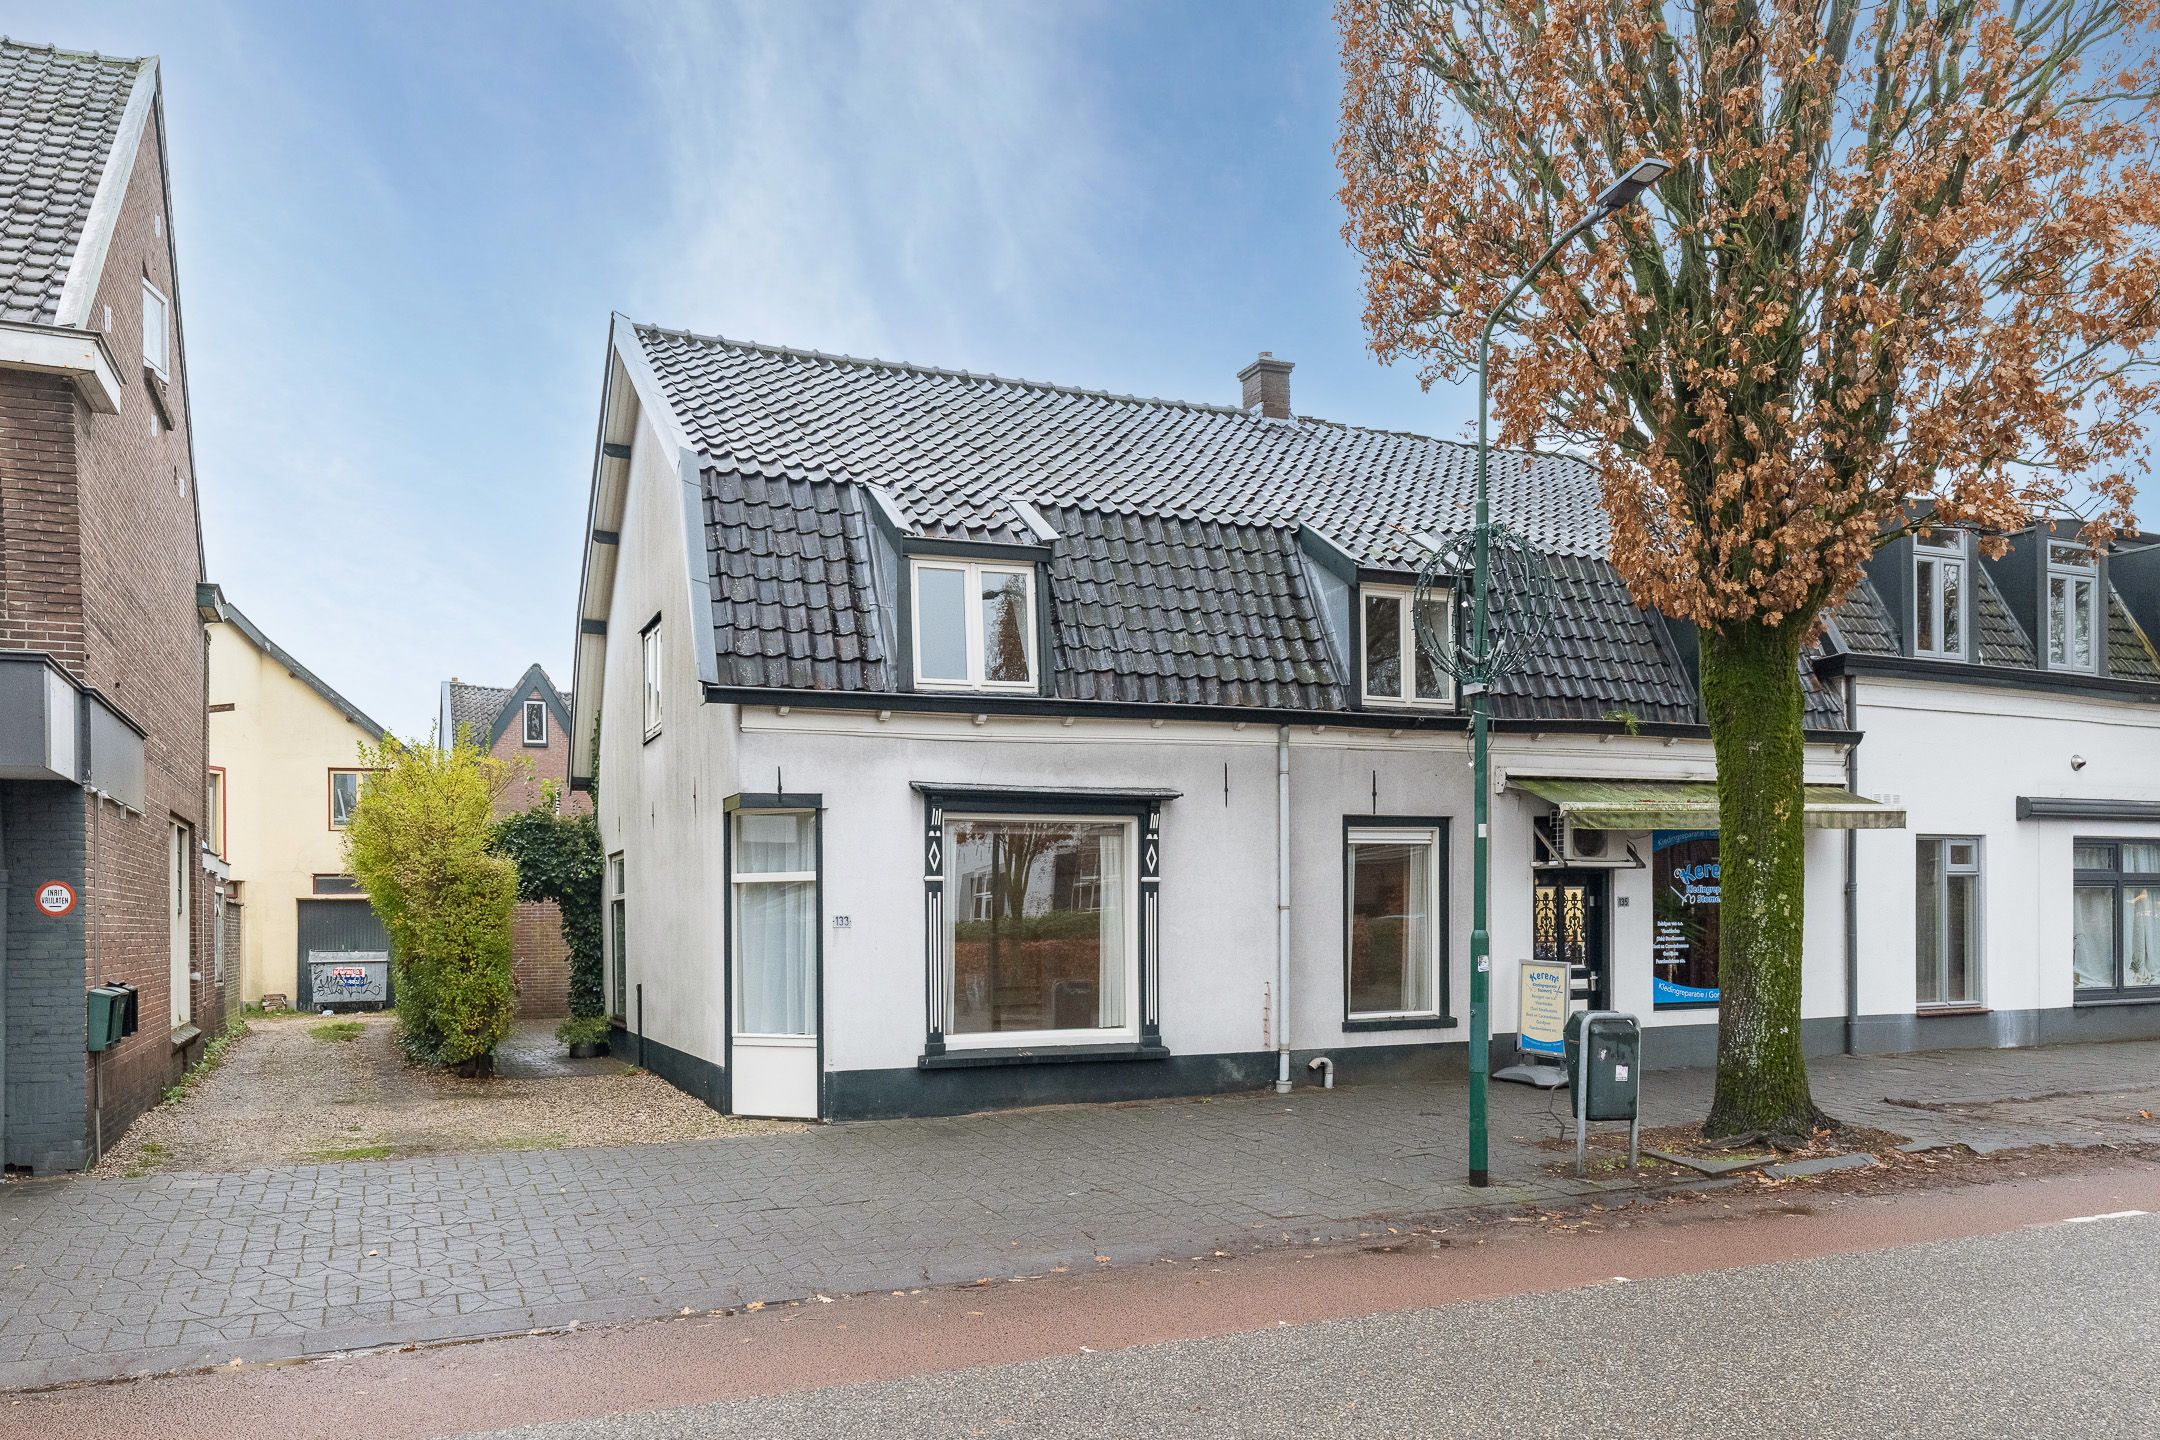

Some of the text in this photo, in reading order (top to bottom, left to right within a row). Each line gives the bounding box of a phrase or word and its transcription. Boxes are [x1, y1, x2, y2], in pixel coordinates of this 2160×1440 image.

[1680, 863, 1720, 885] Kere
[1685, 885, 1721, 896] Kledingrep
[1617, 896, 1630, 907] 135
[1696, 895, 1721, 904] Stome
[835, 915, 849, 926] 133
[1658, 982, 1705, 998] Kledingreparatie
